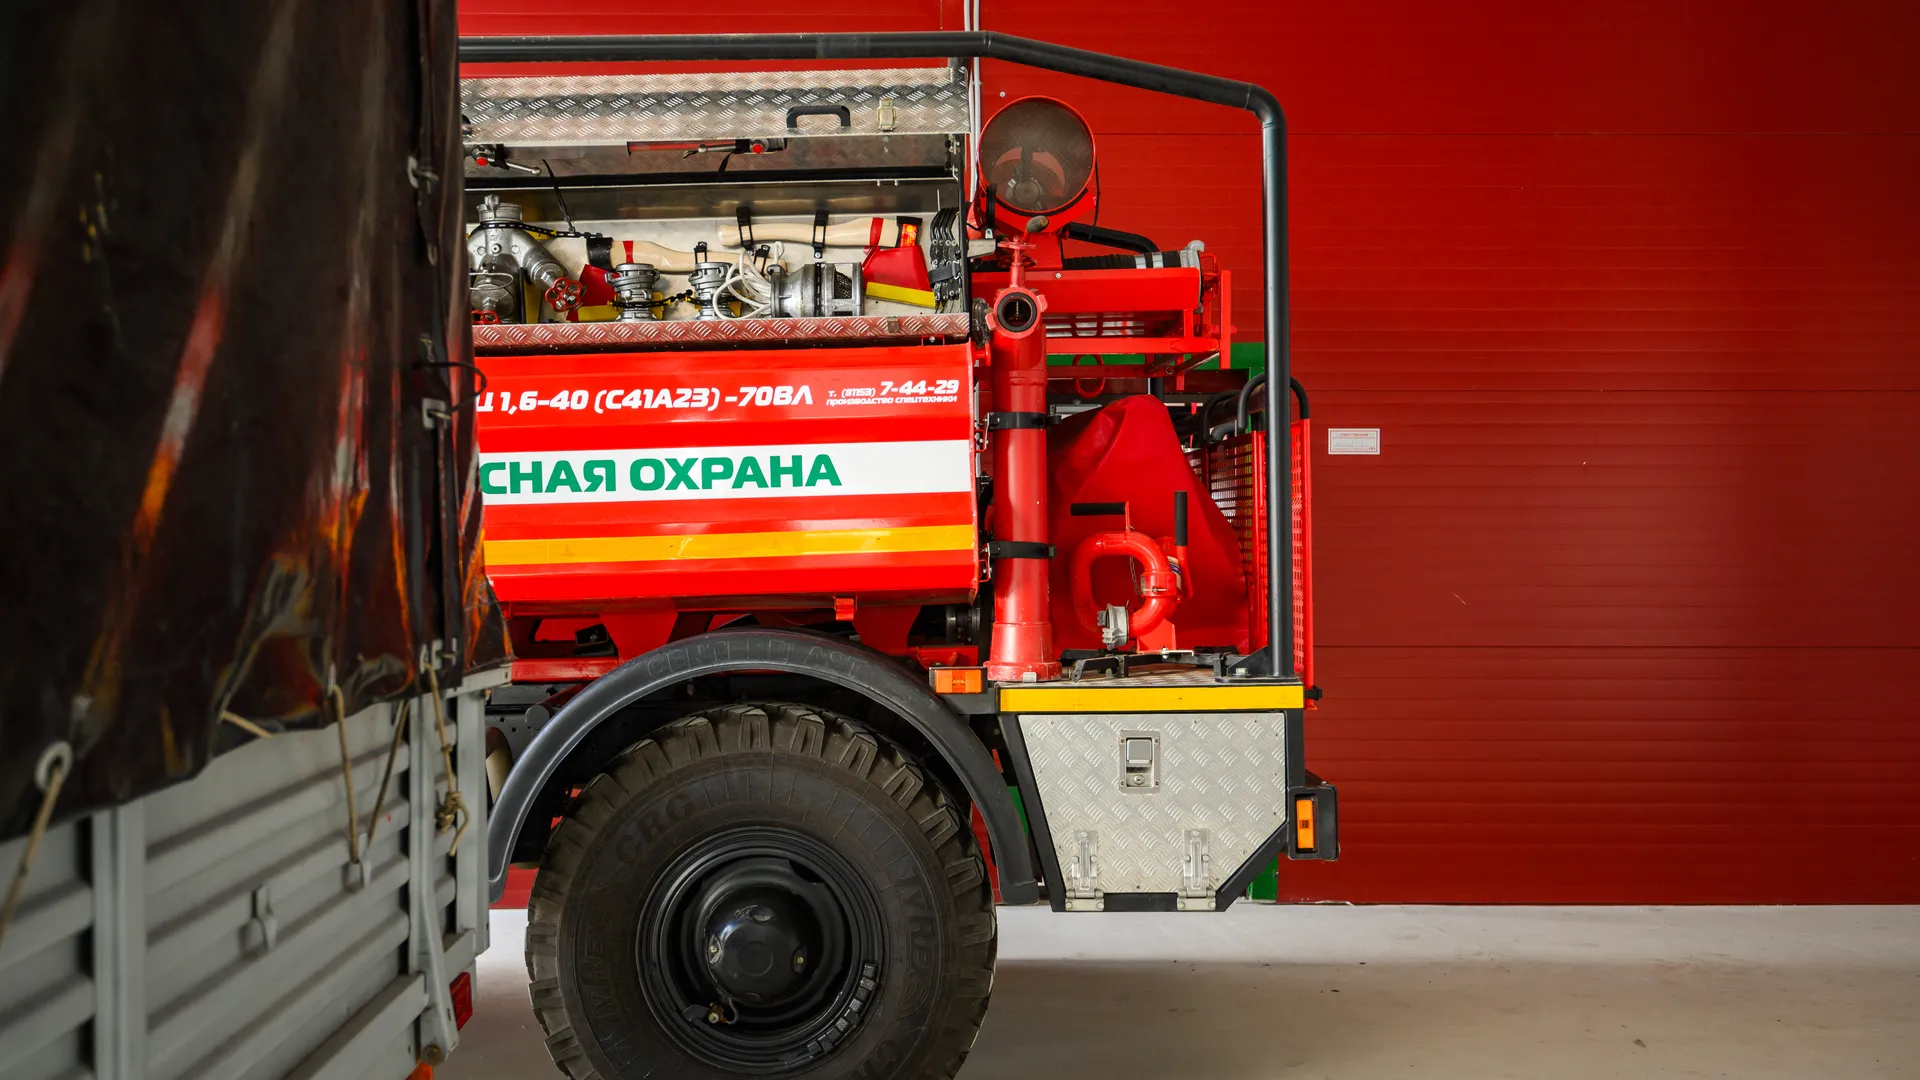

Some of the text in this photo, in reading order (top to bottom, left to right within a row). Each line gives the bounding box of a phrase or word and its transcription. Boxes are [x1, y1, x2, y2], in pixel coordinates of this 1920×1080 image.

[501, 390, 589, 414] 1,6-40
[594, 388, 720, 413] (С41А23)
[725, 385, 813, 406] -70ВЛ
[828, 390, 837, 398] т.
[880, 380, 959, 396] 7-44-29
[826, 395, 958, 407] производство спецтехники
[480, 454, 842, 495] СНАЯ ОХРАНА
